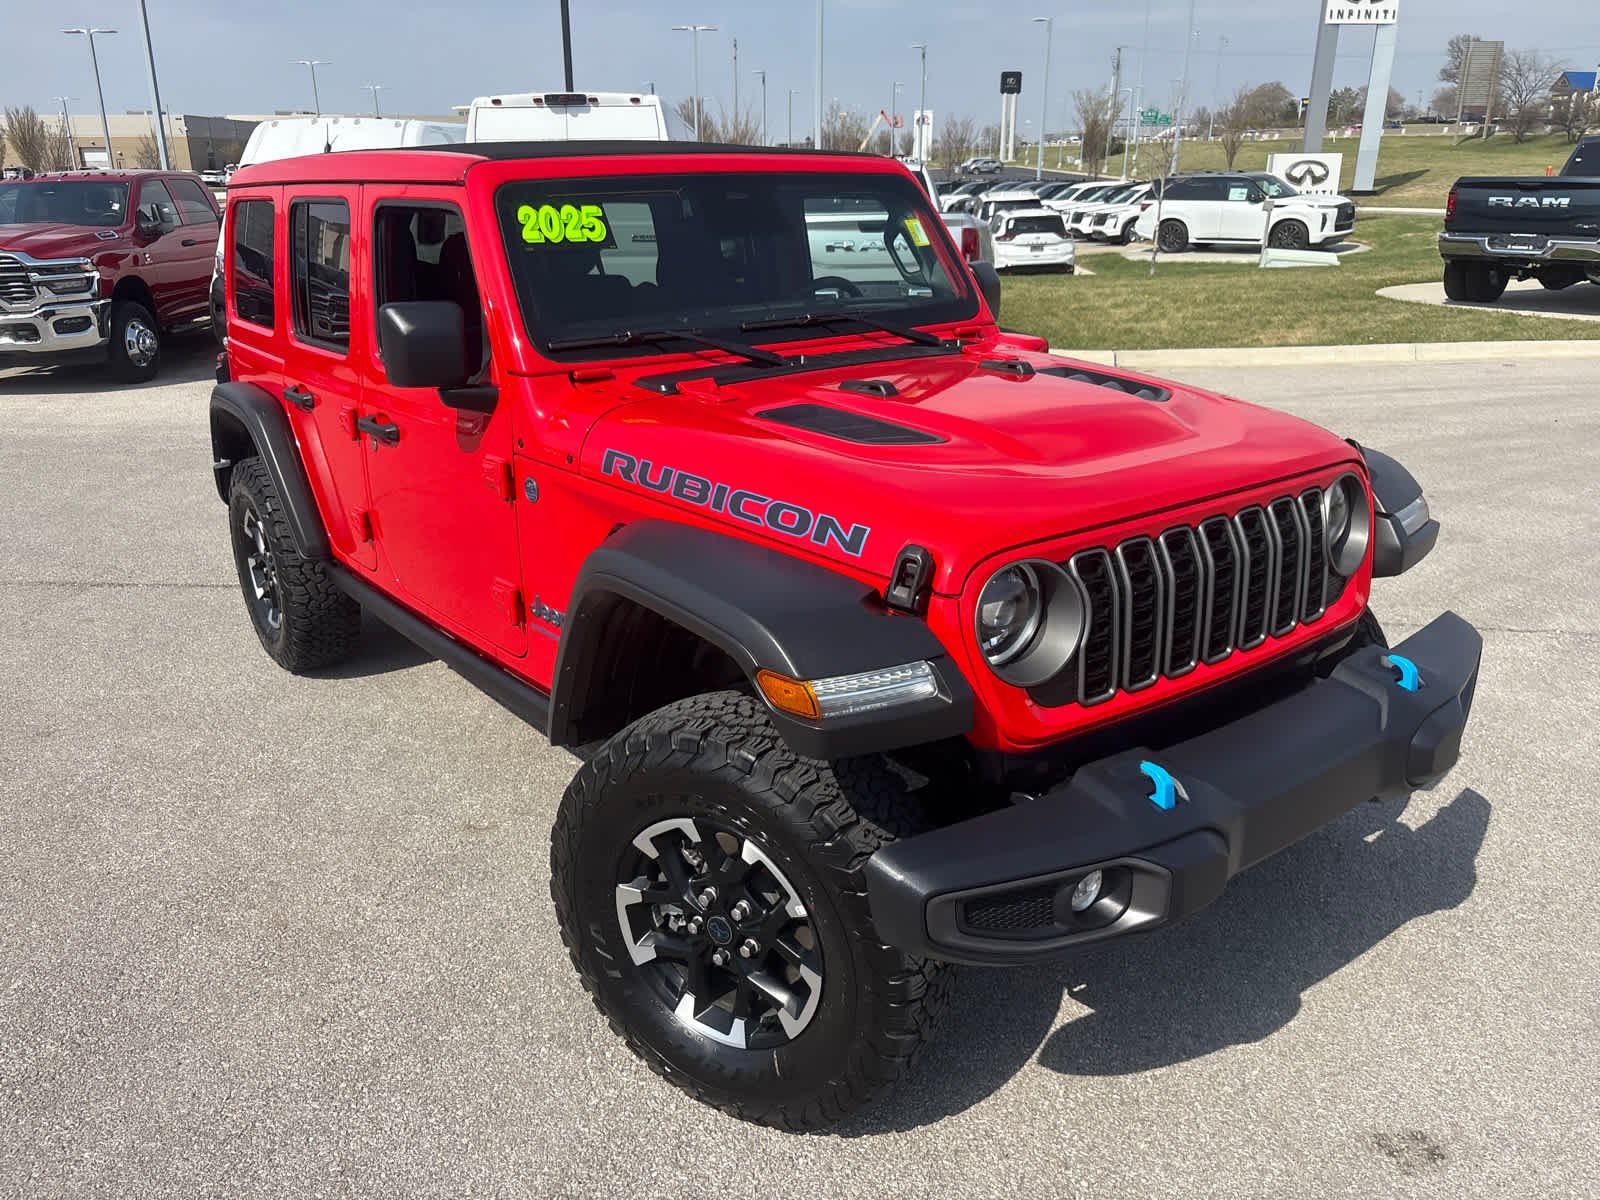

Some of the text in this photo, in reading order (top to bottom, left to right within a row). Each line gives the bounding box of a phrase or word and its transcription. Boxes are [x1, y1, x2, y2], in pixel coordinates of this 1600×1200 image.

[1329, 9, 1396, 20] INFINITI
[1487, 196, 1571, 208] RAM
[517, 204, 607, 243] 2025
[601, 447, 871, 557] RUBICON
